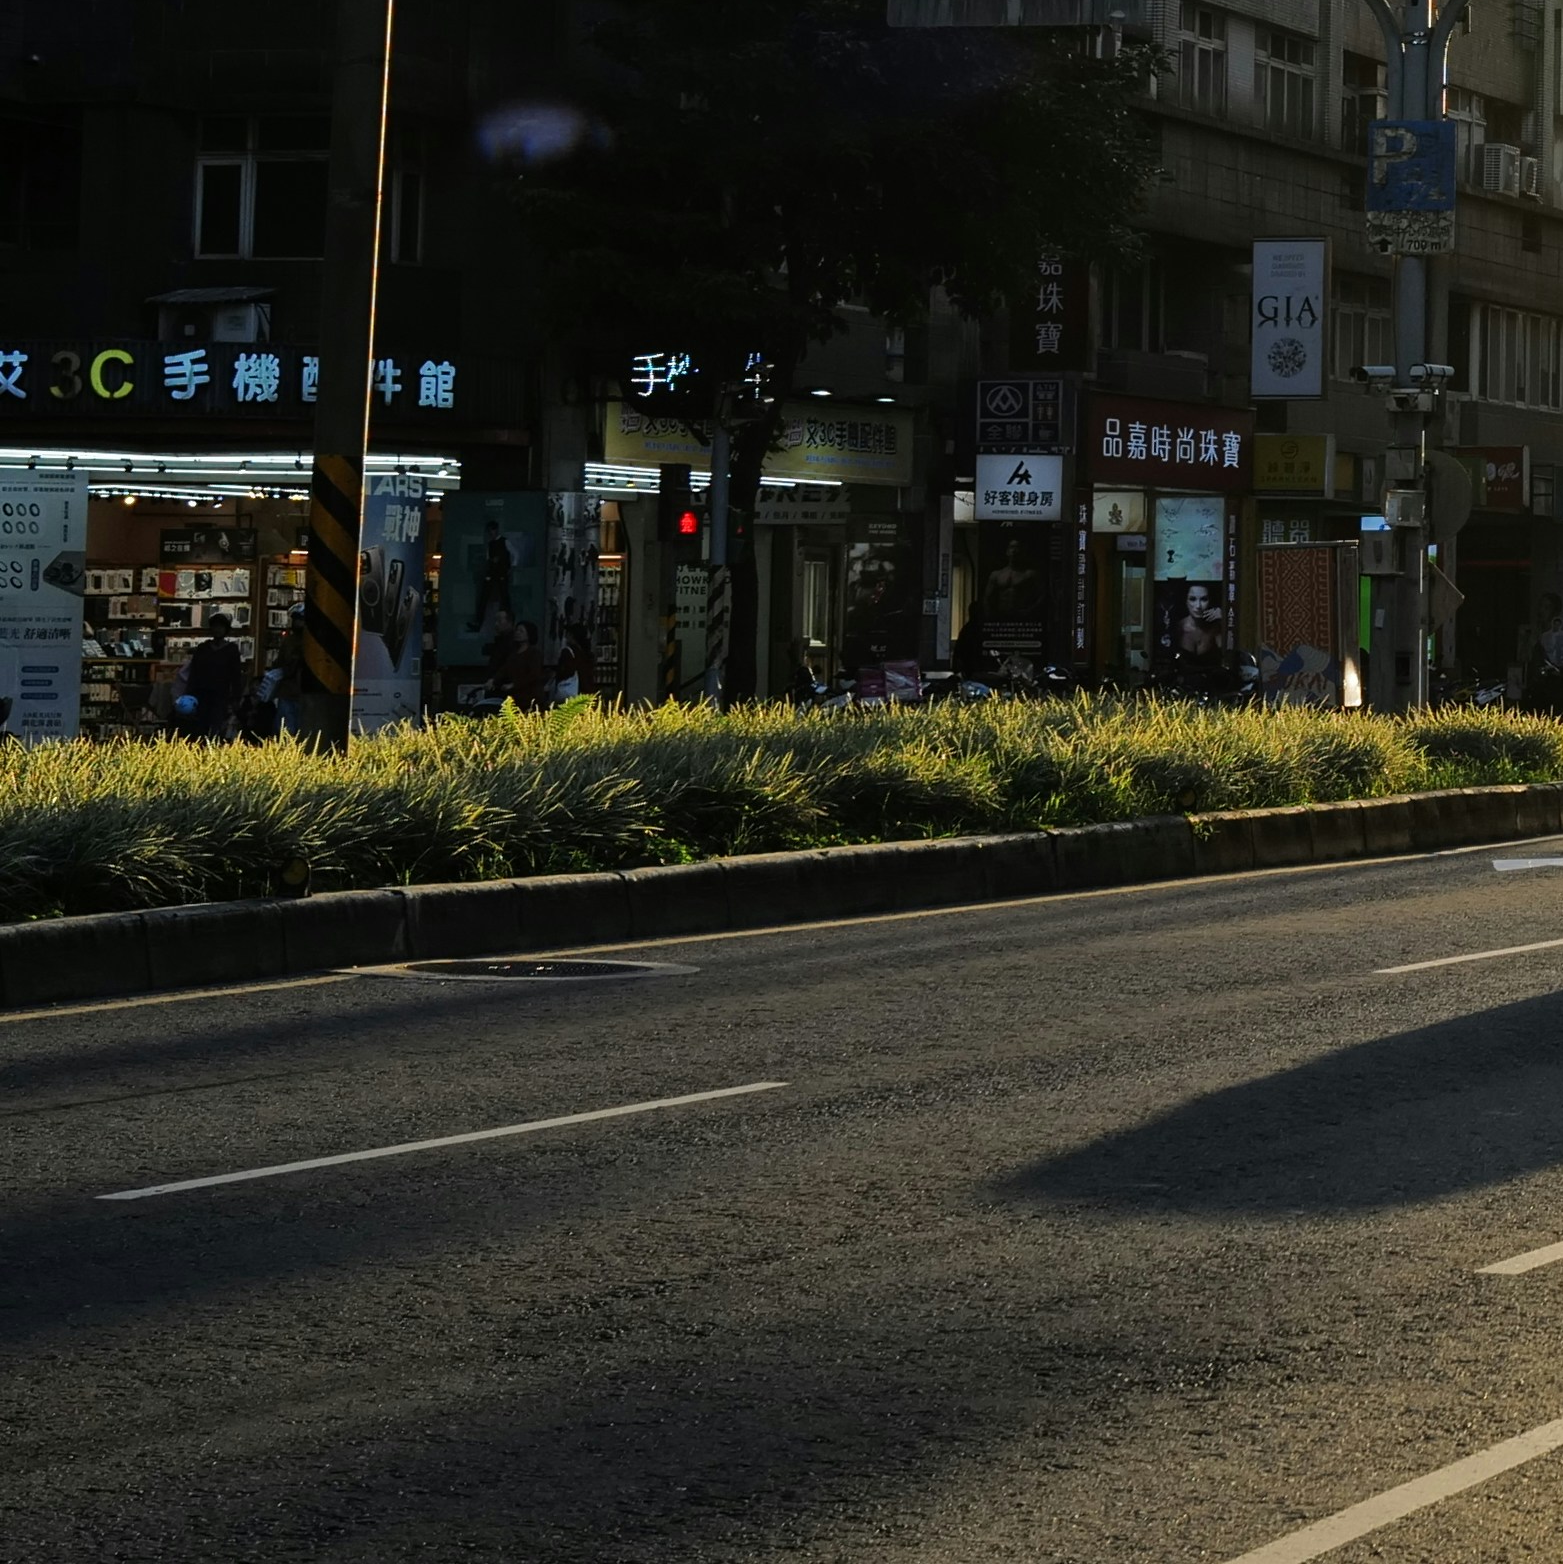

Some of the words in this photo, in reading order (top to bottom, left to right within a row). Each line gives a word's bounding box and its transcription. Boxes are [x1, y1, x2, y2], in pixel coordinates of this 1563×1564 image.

[1373, 127, 1417, 185] P
[1407, 240, 1428, 251] 700
[1257, 295, 1317, 321] GIA
[986, 424, 1022, 441] 全聯
[1102, 417, 1242, 469] 品嘉時尚珠寶
[983, 489, 1055, 507] 好客健身房
[382, 504, 422, 543] 戰神
